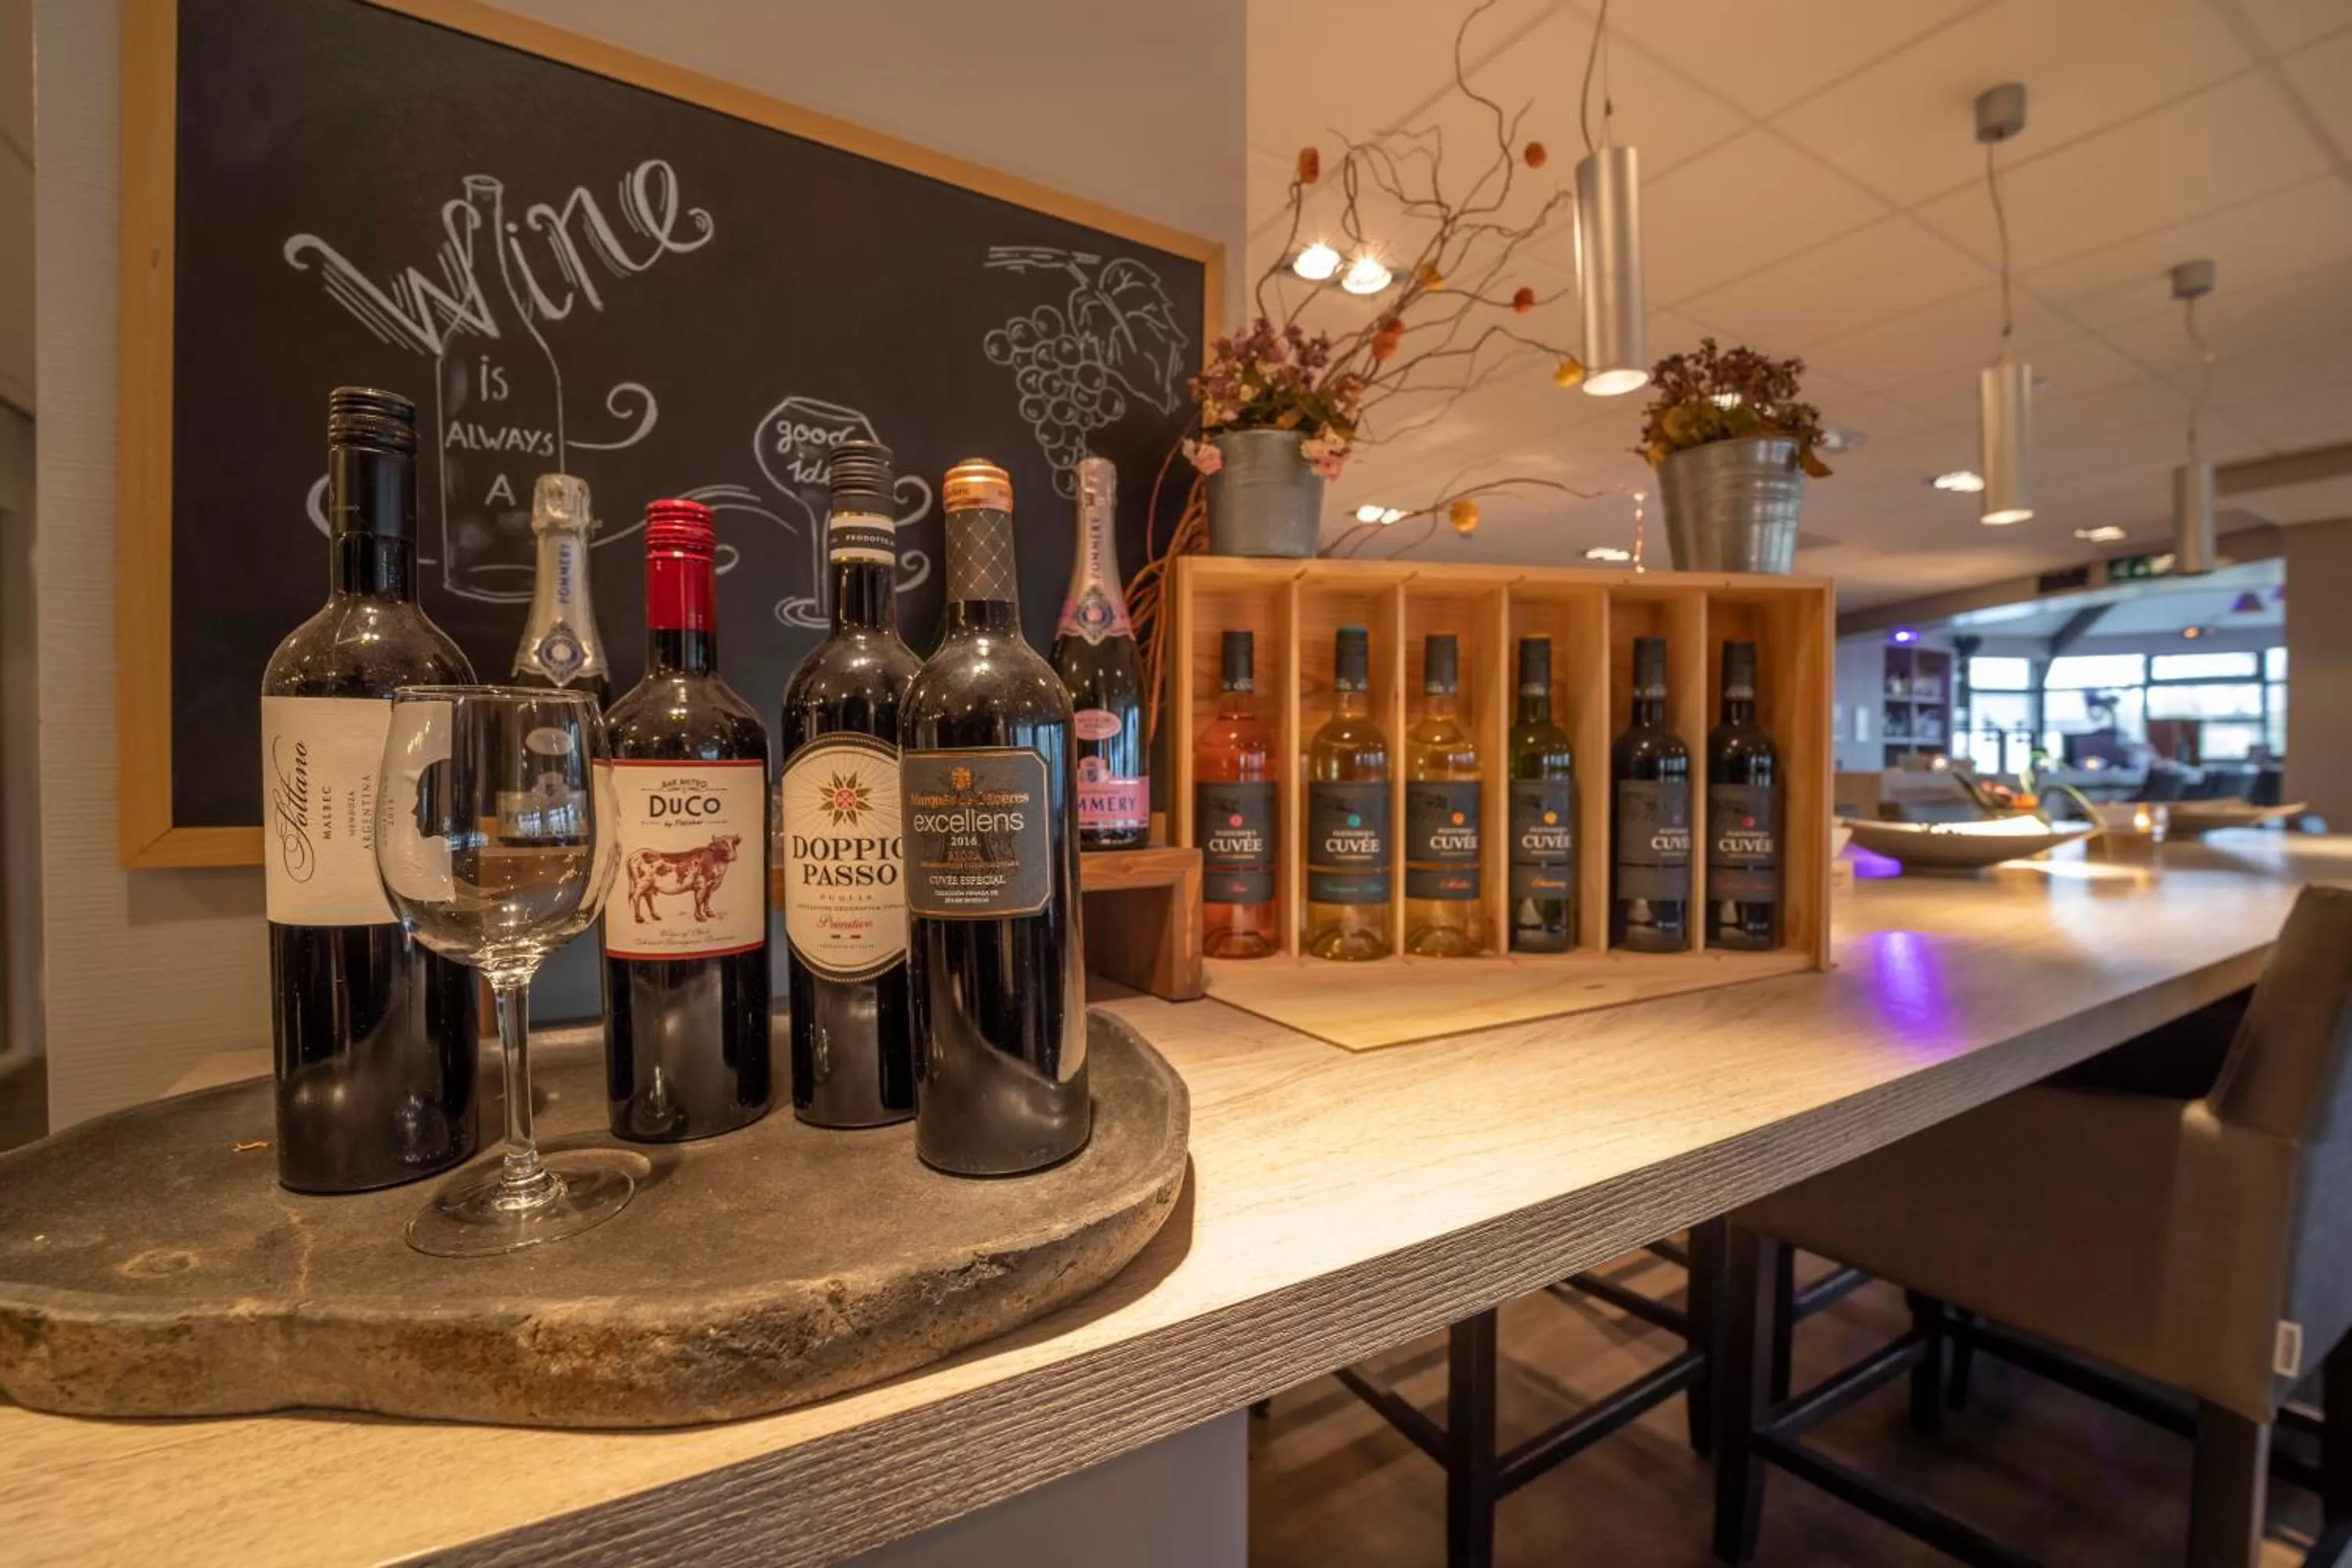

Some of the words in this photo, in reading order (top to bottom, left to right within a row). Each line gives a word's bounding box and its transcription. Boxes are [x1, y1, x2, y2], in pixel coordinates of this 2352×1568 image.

[283, 159, 714, 355] Wine
[480, 355, 509, 401] is
[445, 419, 554, 457] ALWAYS
[775, 419, 856, 455] good
[484, 473, 517, 506] A
[321, 786, 332, 840] MALBEC
[361, 775, 373, 851] ARGENTINA
[913, 808, 1024, 833] excellens
[1079, 797, 1136, 811] MMERY
[1208, 833, 1263, 852] CUVÉE
[1326, 833, 1381, 853] CUVÉE
[802, 863, 898, 887] PASSO
